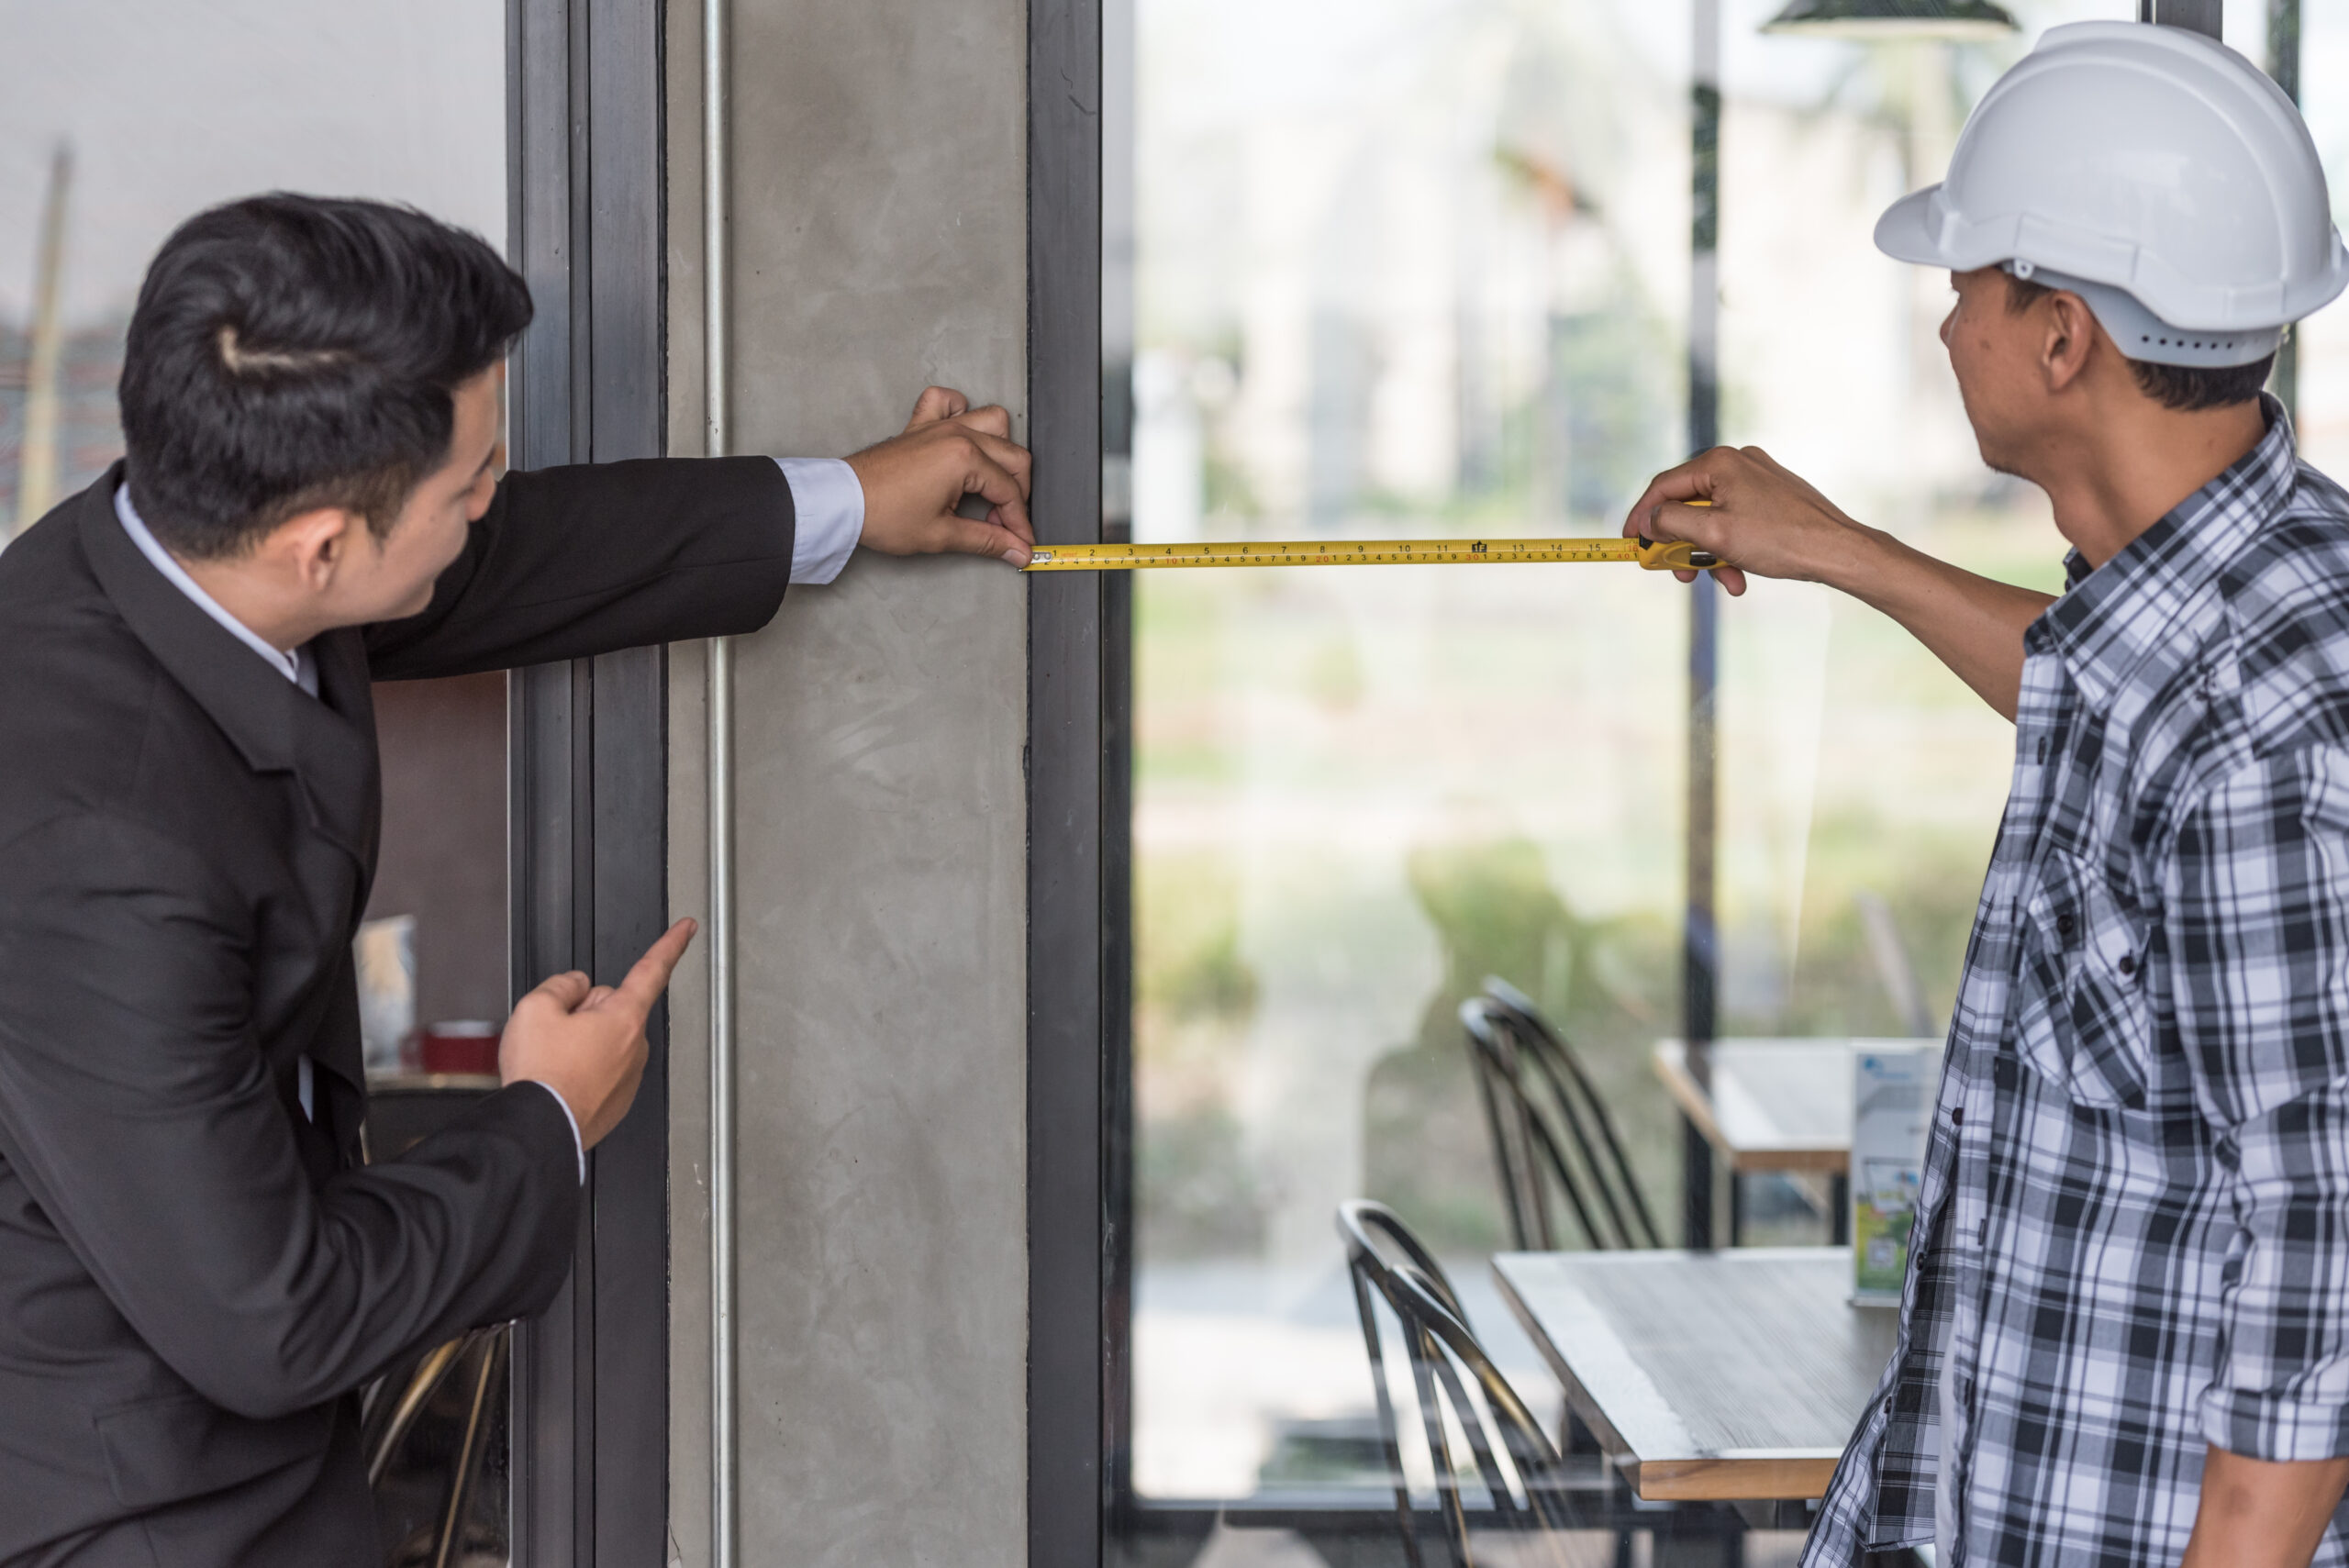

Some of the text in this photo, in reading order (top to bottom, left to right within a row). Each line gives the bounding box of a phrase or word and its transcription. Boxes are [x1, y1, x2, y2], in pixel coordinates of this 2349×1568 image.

[1089, 549, 1096, 557] 2
[1128, 548, 1134, 556] 3
[1165, 547, 1172, 555] 4
[1203, 547, 1210, 555] 5
[1242, 546, 1249, 554] 6
[1280, 546, 1287, 554] 7
[1319, 545, 1326, 553] 8
[1358, 545, 1364, 553] 9
[1397, 544, 1411, 552] 10
[1436, 544, 1448, 552] 11
[1512, 544, 1525, 552] 13
[1551, 544, 1563, 552] 14
[1588, 543, 1601, 551] 15
[1165, 557, 1177, 565] 10
[1315, 555, 1330, 563] 20
